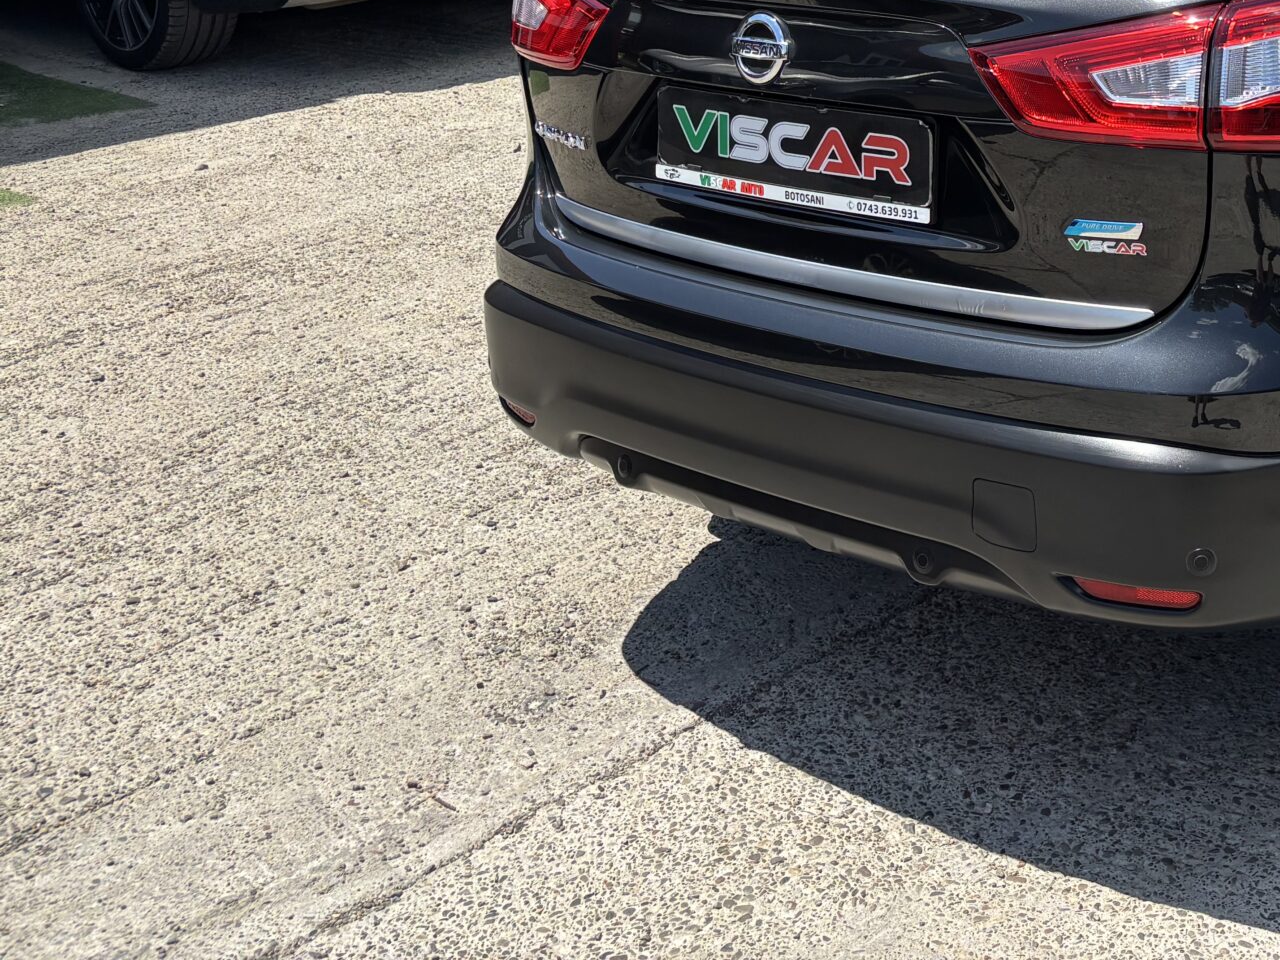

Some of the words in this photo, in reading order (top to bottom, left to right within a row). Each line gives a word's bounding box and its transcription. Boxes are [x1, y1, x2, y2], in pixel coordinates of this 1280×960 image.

[735, 40, 783, 57] NISSAN
[672, 104, 912, 186] VISCAR
[699, 173, 737, 192] VISCAR
[740, 181, 765, 197] AUTO
[784, 191, 825, 206] BOTOSANI
[856, 201, 920, 221] 0743.639.931
[1067, 237, 1147, 256] VISCAR
